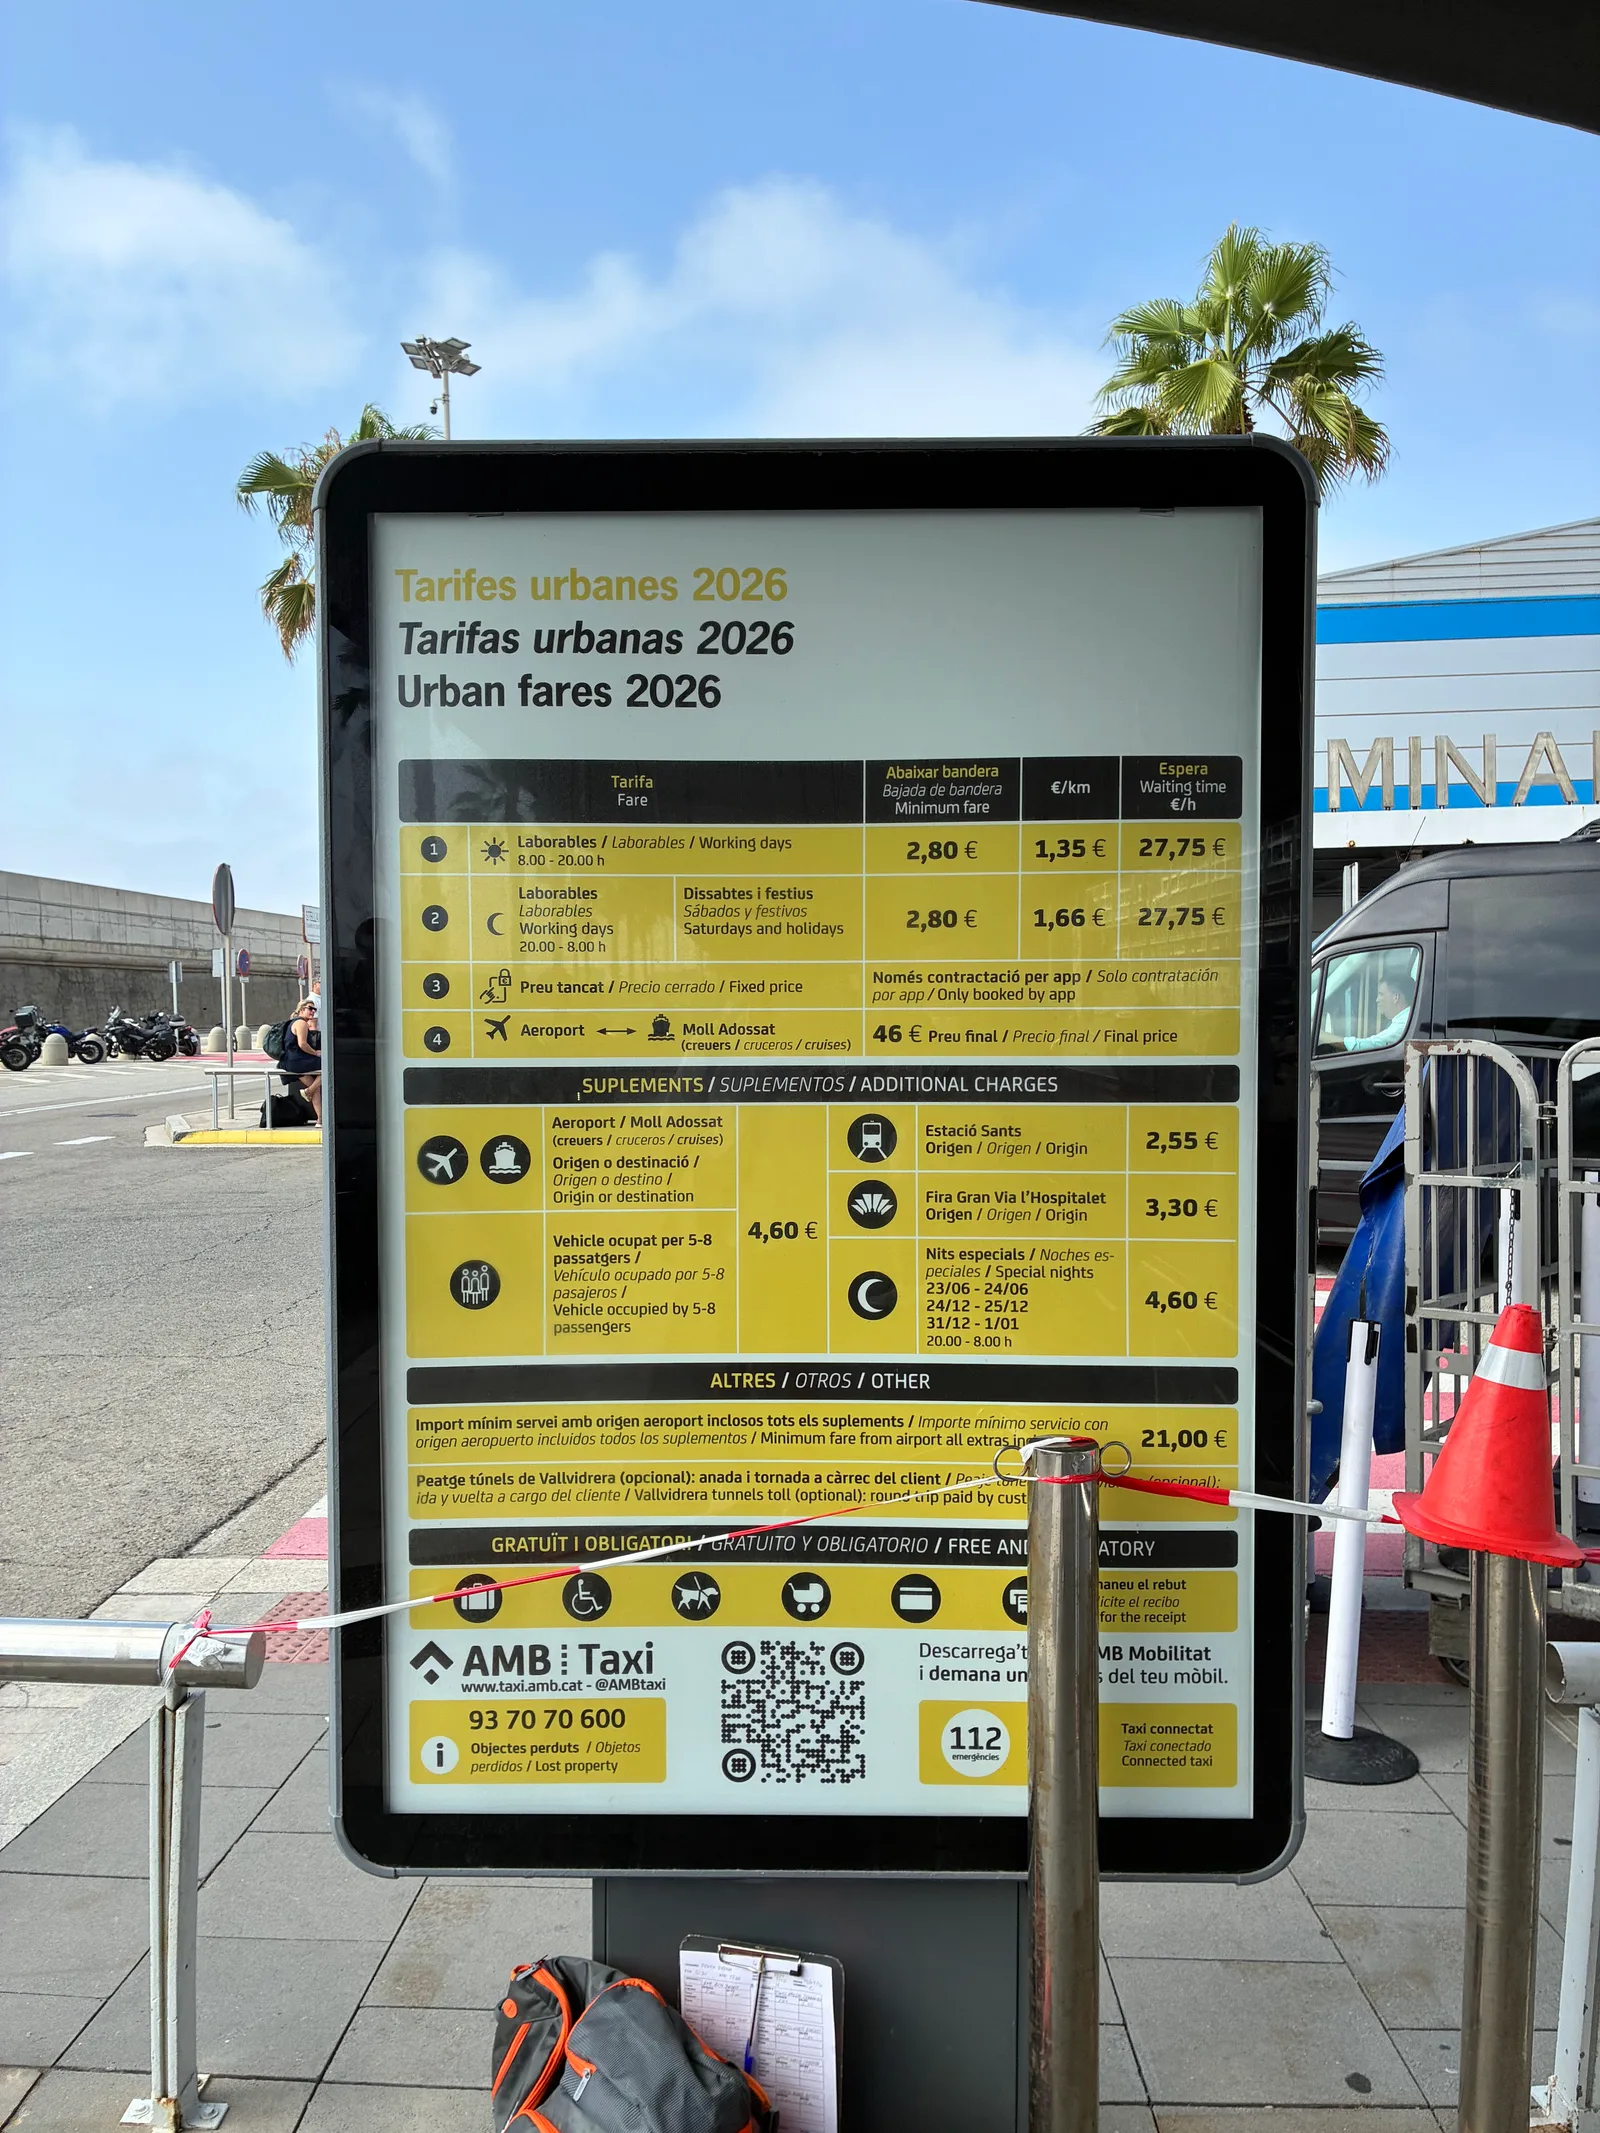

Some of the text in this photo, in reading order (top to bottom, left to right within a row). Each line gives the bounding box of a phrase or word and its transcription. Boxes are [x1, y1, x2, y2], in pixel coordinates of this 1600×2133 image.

[395, 568, 787, 602] Tarifes urbanes 2026
[399, 621, 795, 655] Tarifas urbanas 2026
[398, 674, 721, 708] Urban fares 2026
[885, 764, 999, 780] Abaixar bandera
[1159, 762, 1209, 779] Espera
[1327, 730, 1600, 809] MINA
[610, 775, 654, 789] Tarifa
[1050, 780, 1091, 795] €/km
[1139, 780, 1227, 797] Waiting time
[617, 793, 648, 807] Fare
[882, 782, 1003, 801] Bajada de bandera
[895, 800, 990, 815] Minimum fare
[1170, 798, 1196, 812] €/h
[517, 835, 792, 853] Laborables Laborables Working days
[906, 841, 978, 864] 2,80 €
[1035, 839, 1107, 862] 1,35 €
[1139, 838, 1226, 861] 27,75 €
[517, 854, 605, 867] 8.00 20.00 h
[683, 886, 814, 901] Dissabtes i festius
[906, 910, 978, 932] 2,80 €
[1033, 909, 1106, 931] 1,66 €
[1137, 907, 1226, 930] 27,75 €
[683, 921, 844, 938] Saturdays and holidays
[520, 979, 803, 996] Preu tancat Precio cerrado Fixed price
[520, 1025, 586, 1040] Aeroport
[682, 1022, 776, 1036] Moll Adossat
[872, 1025, 1178, 1046] 46 € Preu final Precio final Final price
[582, 1077, 1058, 1094] SUPLEMENTS SUPLEMENTOS ADDITIONAL CHARGES
[925, 1123, 1022, 1138] Estació Sants
[1145, 1132, 1219, 1153] 2,55 €
[925, 1190, 953, 1204] Fira
[956, 1190, 991, 1204] Gran
[994, 1190, 1017, 1204] Via
[1145, 1199, 1218, 1221] 3,30 €
[552, 1233, 713, 1250] Vehicle ocupat per 5-8
[747, 1222, 818, 1244] 4,60 €
[926, 1247, 955, 1261] Nits
[958, 1248, 1025, 1264] especials
[1039, 1248, 1090, 1262] Noches
[926, 1281, 1028, 1296] 23/06 24/06
[926, 1299, 1028, 1313] 24/12 25/12
[1144, 1291, 1218, 1313] 4,60 €
[926, 1316, 1020, 1331] 31/12 1/01
[710, 1373, 931, 1390] ALTRES OTROS OTHER
[415, 1413, 905, 1434] Import mínim servei amb origen aeroport inclosos tots els suplements
[1141, 1430, 1228, 1452] 21,00 €
[491, 1533, 569, 1553] GRATUÏT
[574, 1537, 579, 1552] I
[710, 1535, 797, 1553] GRATUITO
[802, 1536, 813, 1552] Y
[816, 1536, 929, 1554] OBLIGATORIO
[948, 1539, 992, 1555] FREE
[463, 1641, 653, 1676] AMB Taxi
[1128, 1646, 1212, 1662] Mobilitat
[919, 1665, 1027, 1683] i demana un
[1108, 1668, 1228, 1684] del teu mòbil.
[461, 1678, 666, 1693] www.taxi.amb.cat @AMBtaxi
[469, 1709, 626, 1730] 93 70 70 600
[1120, 1722, 1214, 1735] Taxi connectat
[950, 1727, 1002, 1750] 112
[1123, 1739, 1212, 1752] Taxi conectado
[470, 1742, 641, 1757] Objectes perduts Objetos
[951, 1752, 1000, 1763] emergències
[470, 1760, 619, 1775] perdidos Lost property
[1121, 1754, 1213, 1767] Connected taxi
